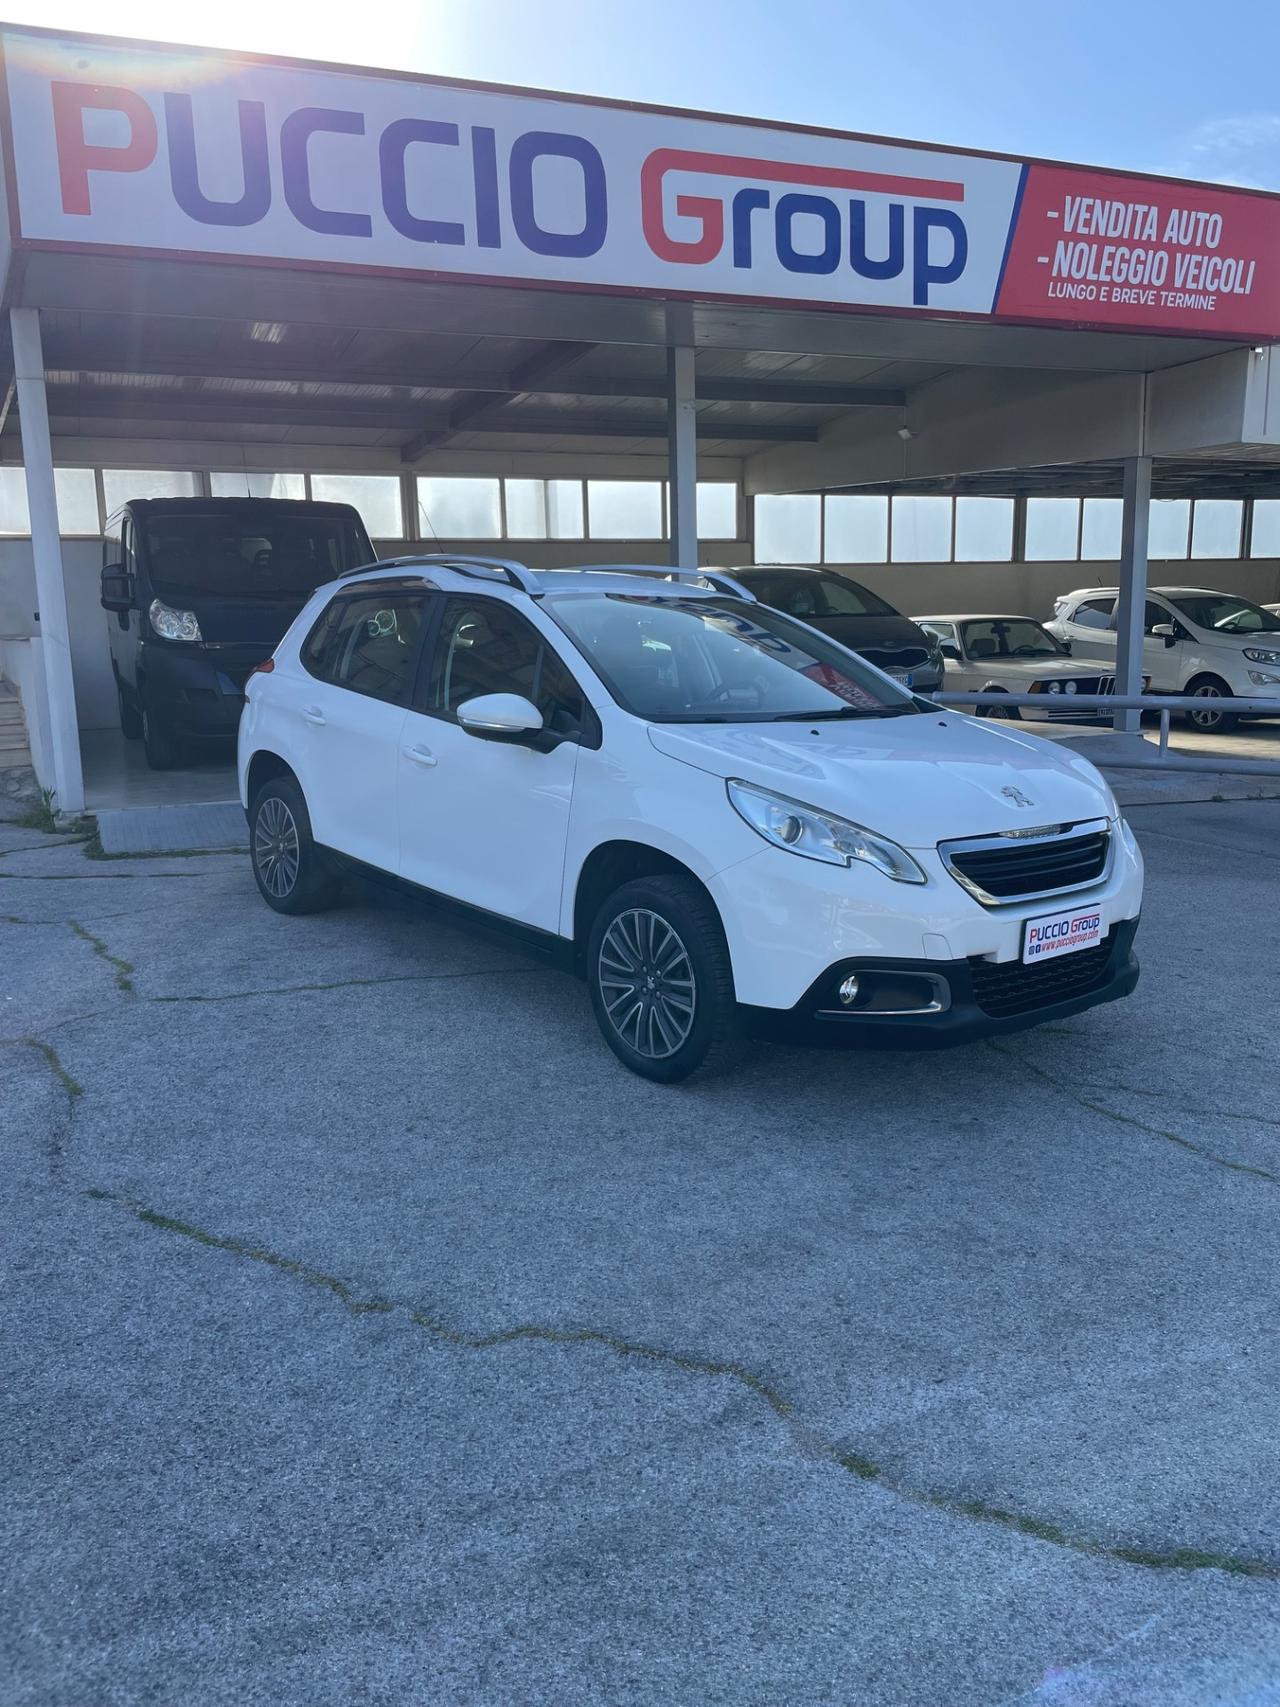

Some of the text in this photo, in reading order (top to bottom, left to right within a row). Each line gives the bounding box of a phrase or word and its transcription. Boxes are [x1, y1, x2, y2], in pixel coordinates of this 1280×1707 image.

[51, 80, 968, 306] PUCCIO Group
[1063, 195, 1159, 242] VENDITA
[1162, 209, 1223, 249] AUTO
[1052, 240, 1169, 287] NOLEGGIO
[1174, 252, 1256, 295] VEICOLI
[1047, 281, 1217, 311] LUNGO E BREVE TERMINE
[1029, 913, 1100, 944] PUCCIO Group
